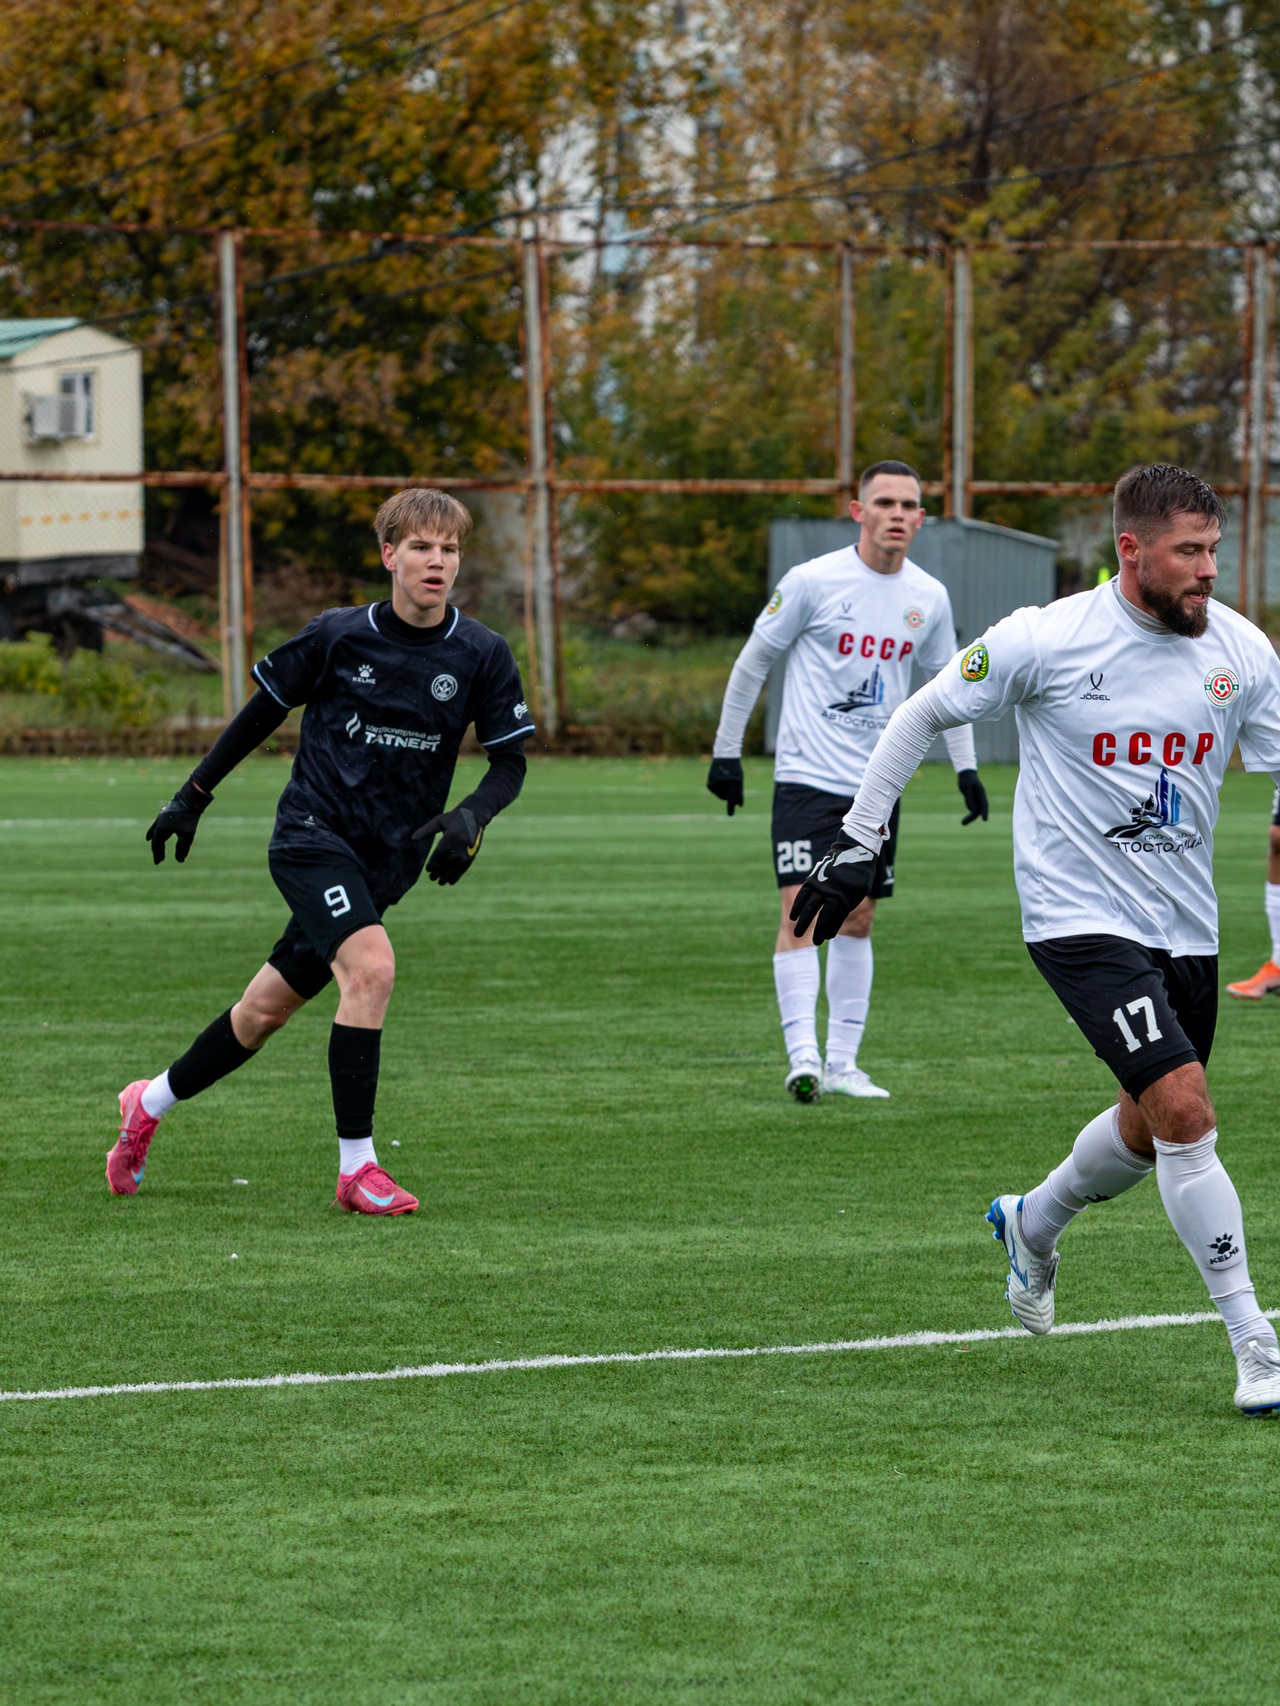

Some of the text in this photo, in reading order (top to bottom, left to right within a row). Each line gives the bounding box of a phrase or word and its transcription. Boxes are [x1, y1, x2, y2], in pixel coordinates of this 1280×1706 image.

[838, 632, 914, 661] СССР
[365, 731, 440, 752] TATNEFT
[1092, 731, 1214, 767] СССР
[777, 840, 813, 874] 26
[324, 885, 351, 918] 9
[1112, 995, 1163, 1053] 17
[1209, 1245, 1240, 1265] KELME
